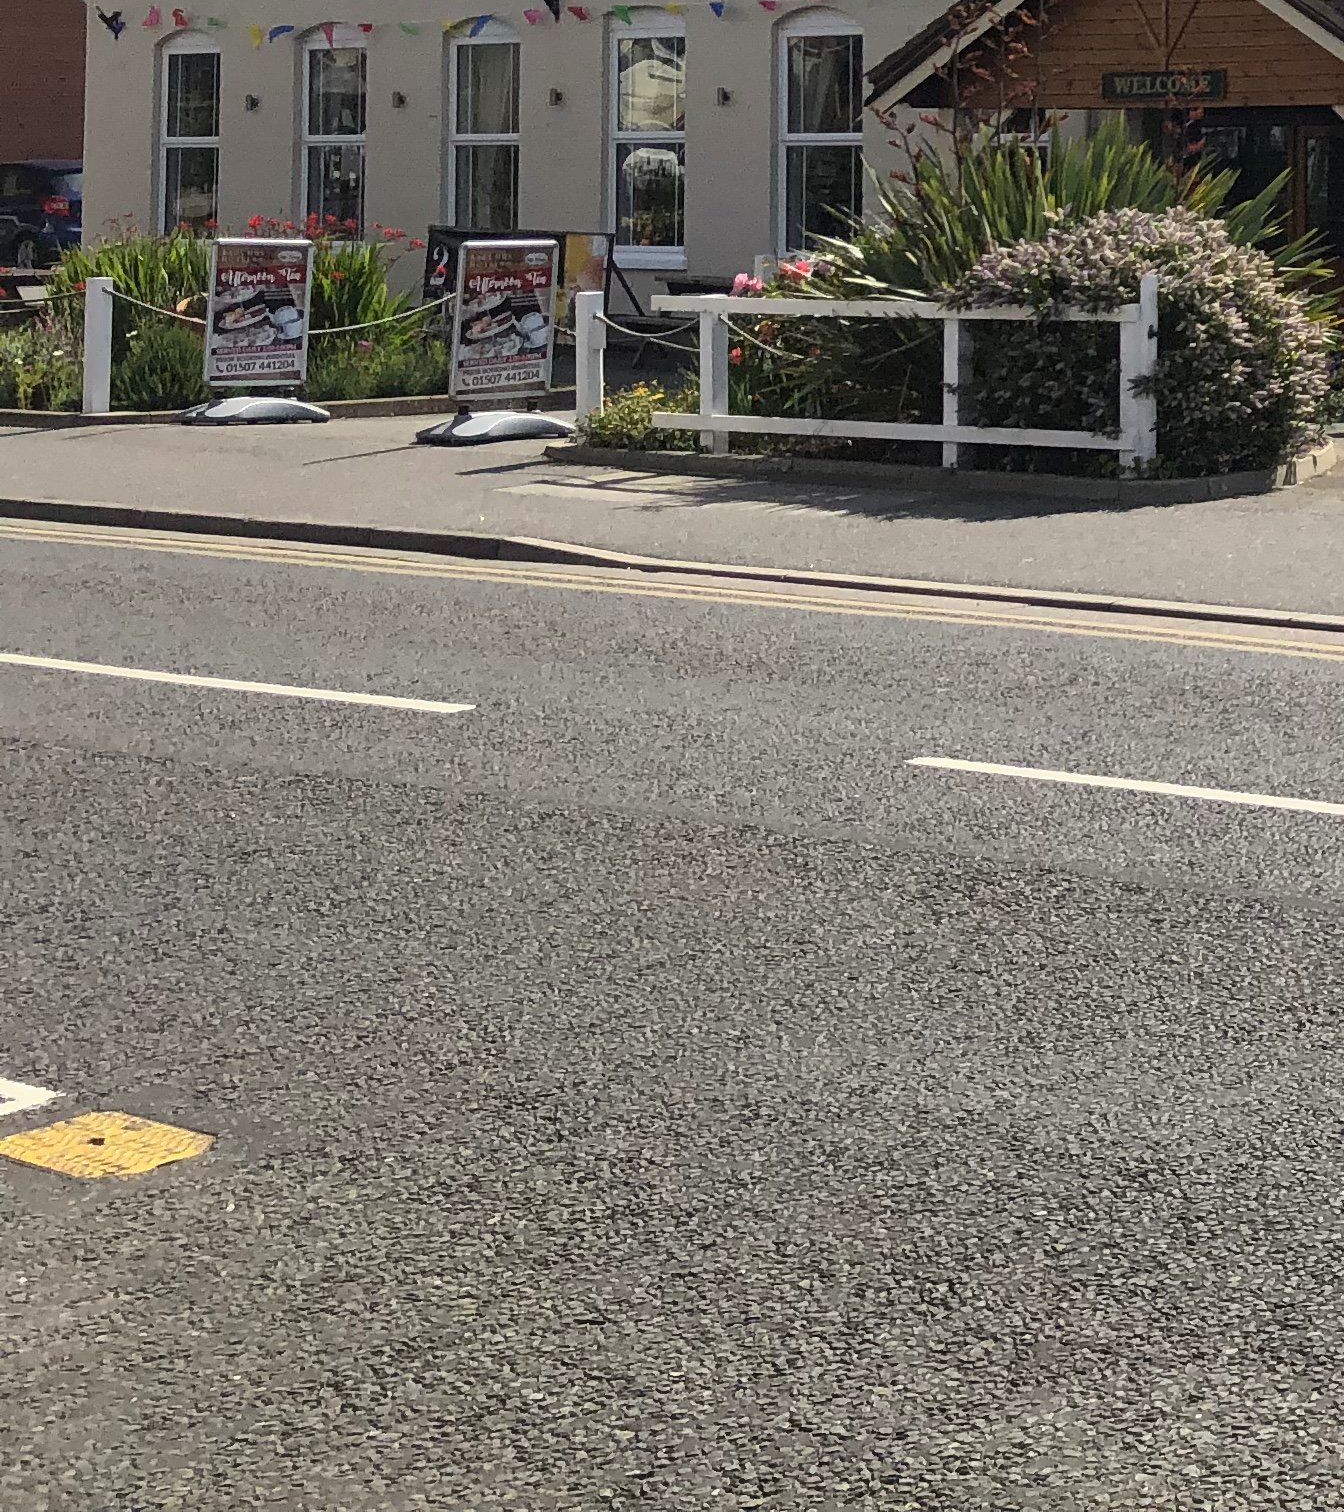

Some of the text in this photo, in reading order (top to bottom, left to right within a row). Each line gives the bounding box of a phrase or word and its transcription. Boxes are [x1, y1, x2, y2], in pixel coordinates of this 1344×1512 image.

[225, 359, 296, 373] 01507 441204
[471, 369, 540, 387] 01507 441204
